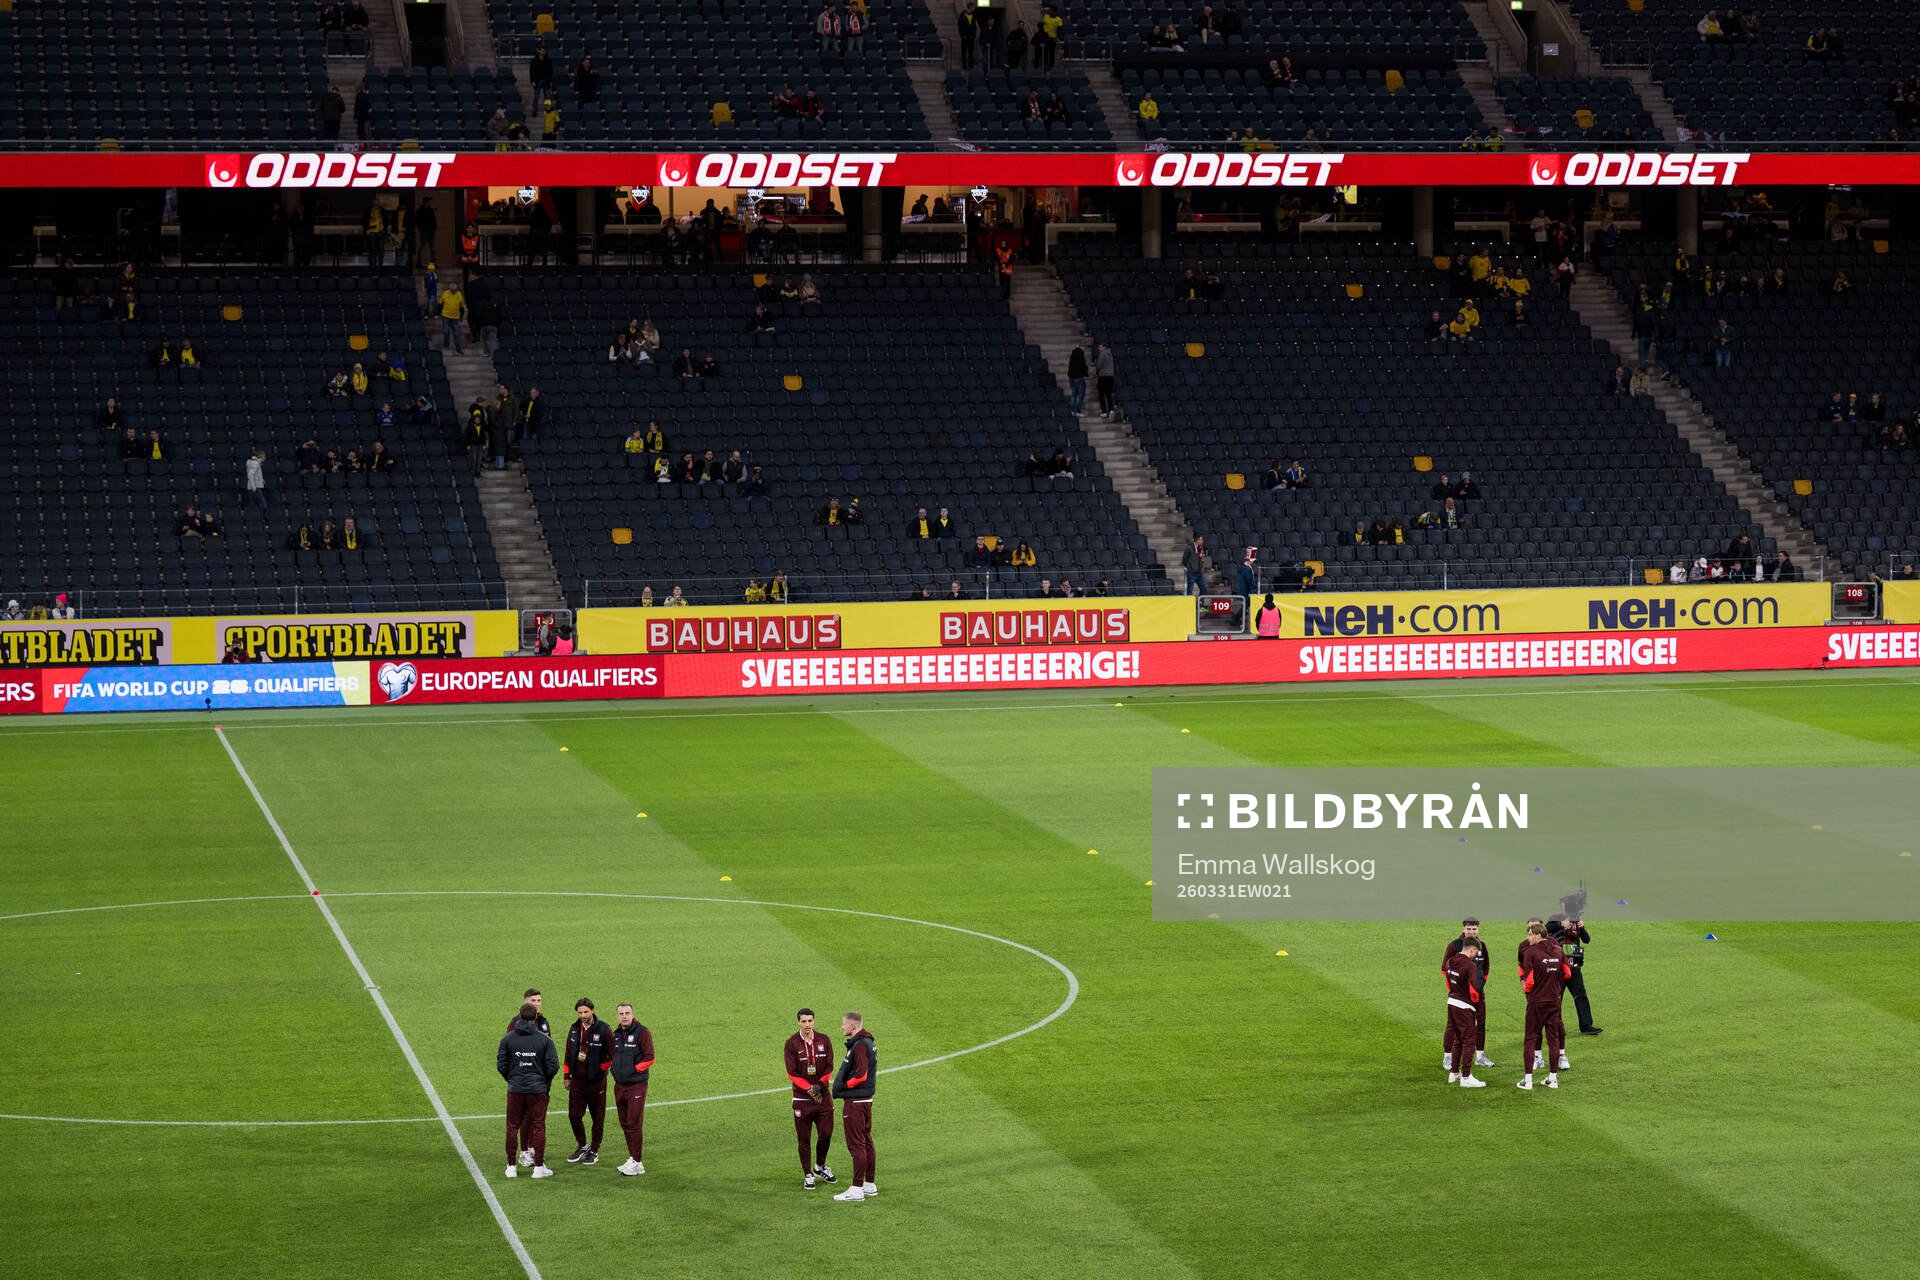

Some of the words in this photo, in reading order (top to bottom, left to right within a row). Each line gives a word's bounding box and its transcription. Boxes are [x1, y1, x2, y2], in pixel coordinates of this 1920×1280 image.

[246, 153, 456, 187] ODDSET
[696, 153, 897, 187] ODDSET
[1151, 153, 1344, 186] ODDSET
[1564, 153, 1750, 186] ODDSET
[1213, 602, 1230, 611] 109
[1847, 588, 1863, 597] 108
[0, 629, 162, 664] TBLADET
[225, 621, 466, 660] SPORTBLADET
[53, 682, 94, 698] FIFA
[98, 680, 167, 697] WORLD
[170, 679, 209, 695] CUP
[254, 676, 359, 693] QUALIFIERS
[421, 670, 533, 691] EUROPEAN
[540, 667, 658, 688] QUALIFIERS
